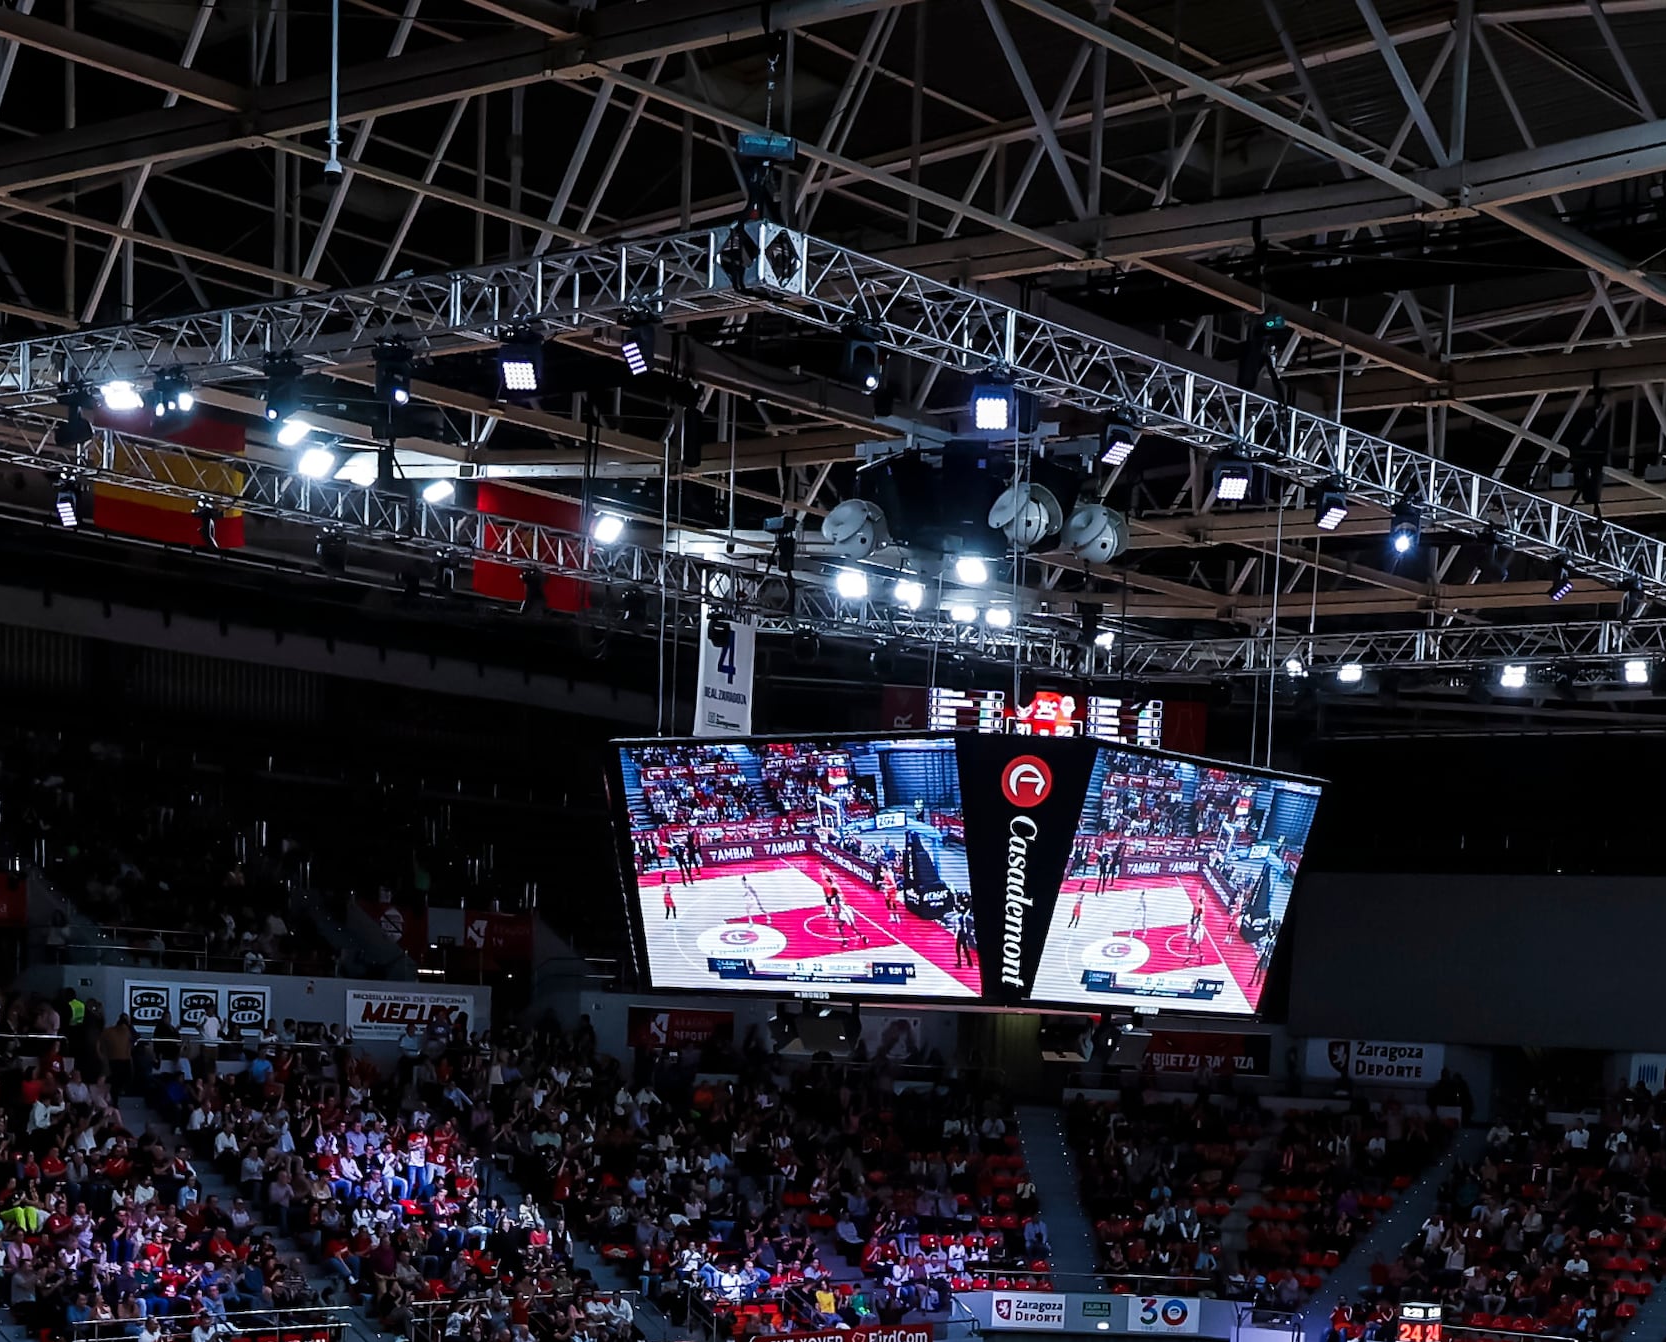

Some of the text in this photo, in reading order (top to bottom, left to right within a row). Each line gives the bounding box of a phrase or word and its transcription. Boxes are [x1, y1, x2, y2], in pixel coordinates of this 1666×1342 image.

[717, 630, 736, 685] 4
[1001, 815, 1038, 988] Casademont
[1356, 1041, 1424, 1061] Zaragoza
[1016, 1298, 1064, 1312] Zaragoza
[1140, 1298, 1189, 1326] 30
[1399, 1323, 1422, 1342] 24
